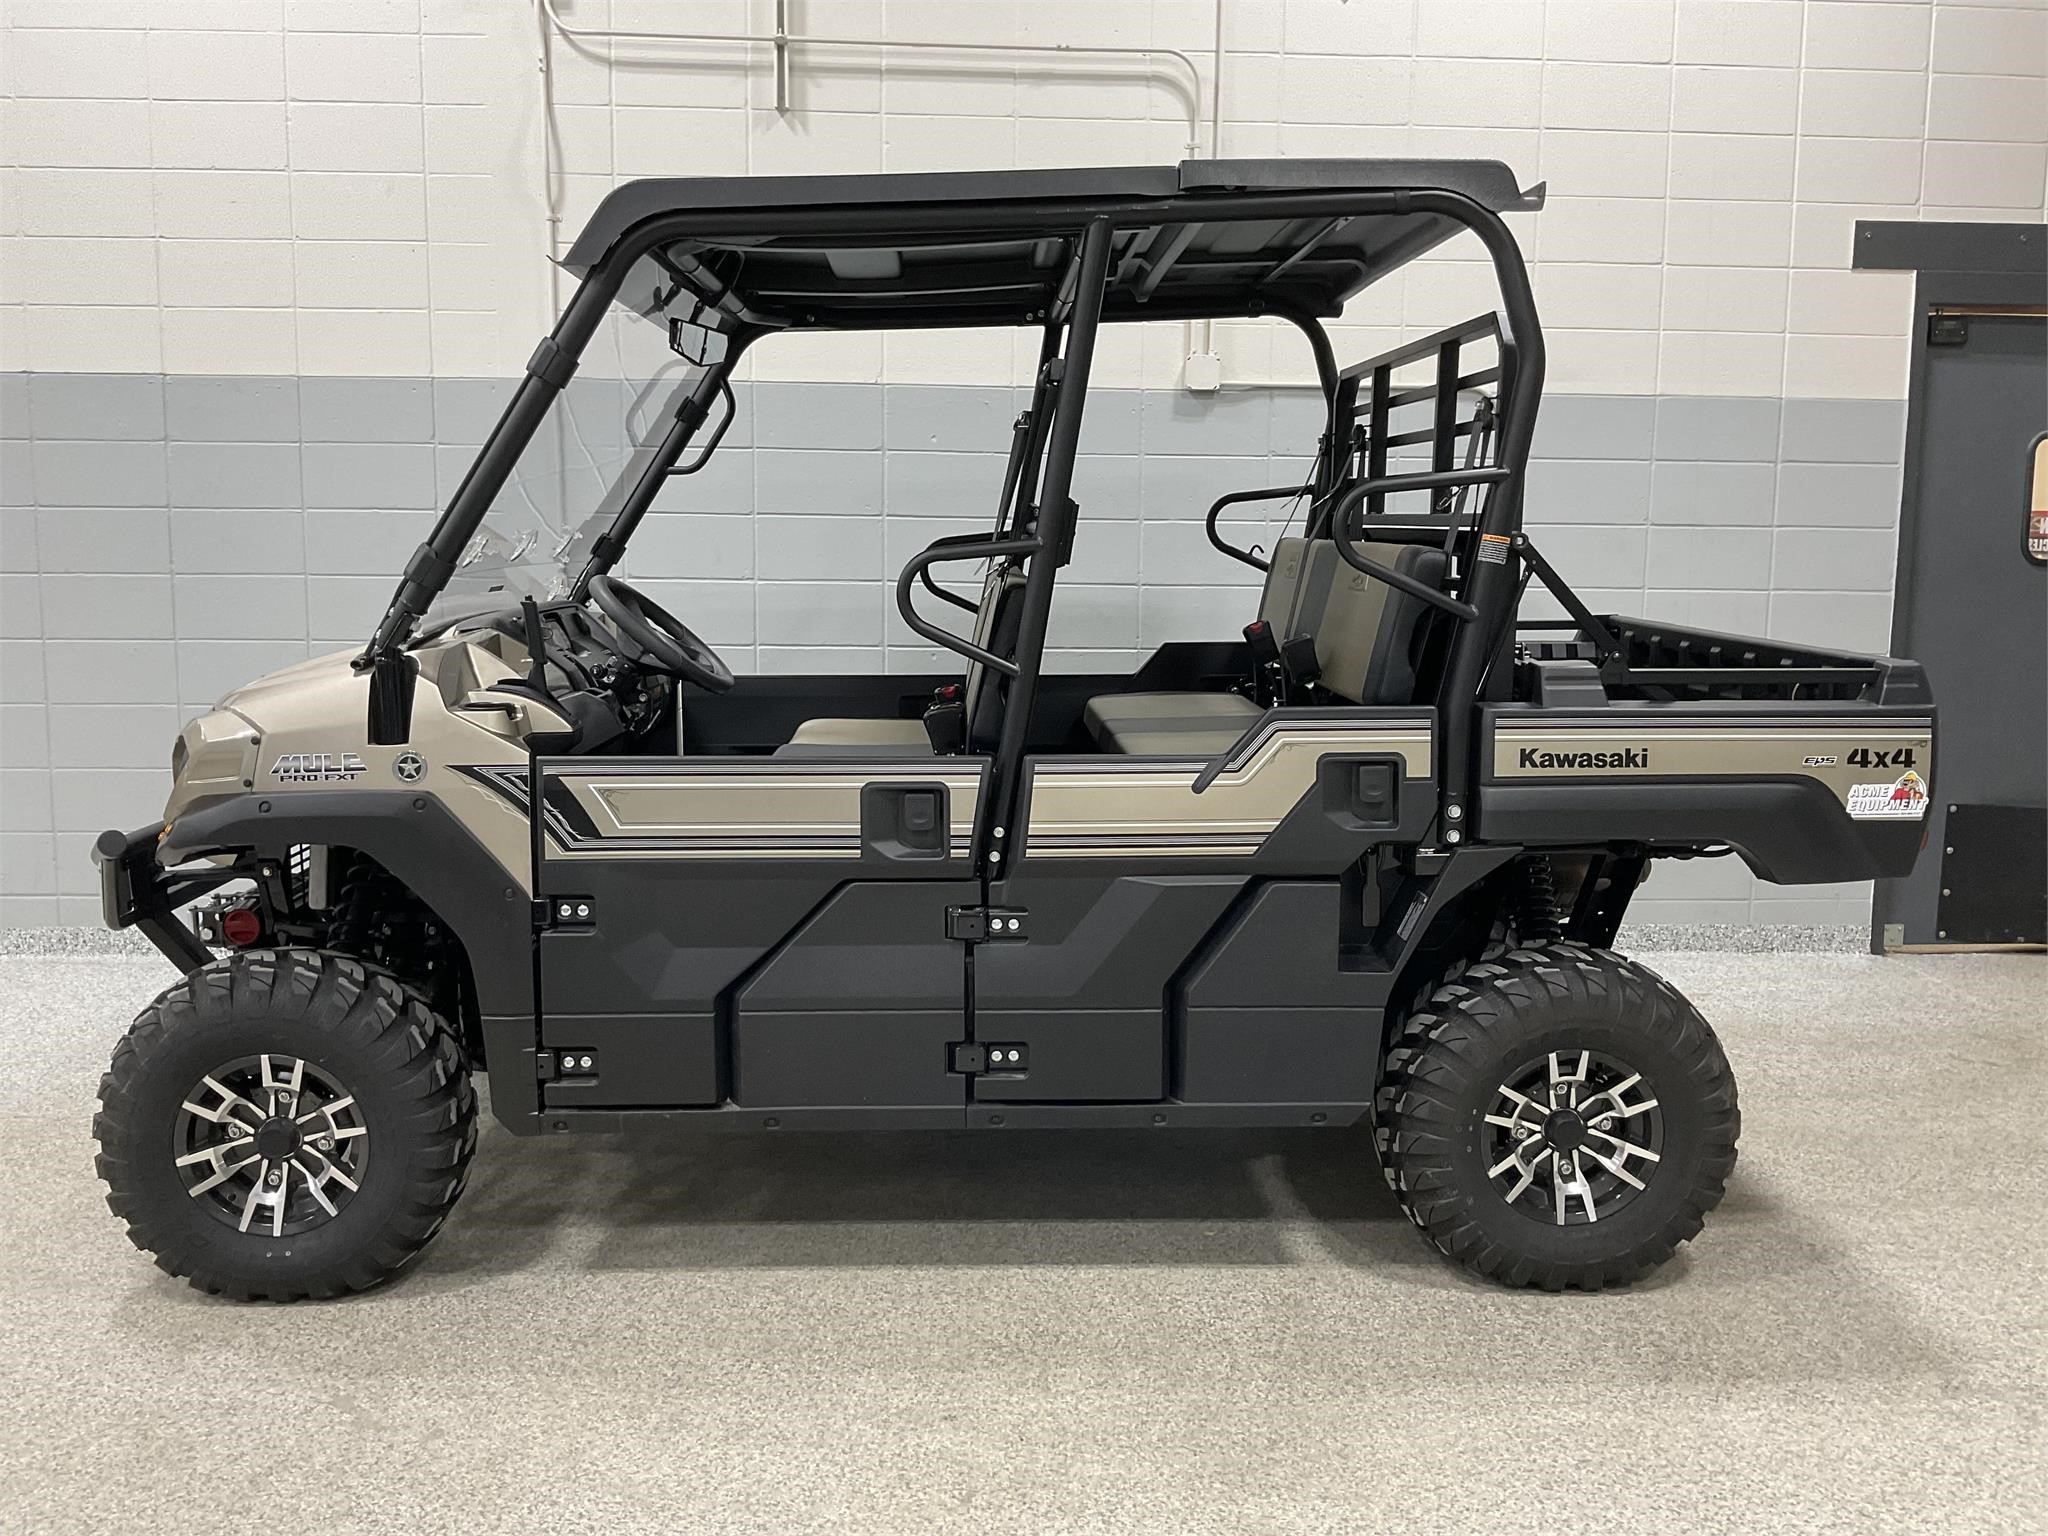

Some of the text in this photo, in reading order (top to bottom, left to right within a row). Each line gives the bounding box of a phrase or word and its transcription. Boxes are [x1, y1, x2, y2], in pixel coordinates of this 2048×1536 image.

[270, 753, 368, 775] MULE
[1519, 747, 1648, 769] Kawasaki
[1847, 748, 1916, 768] 4x4
[1850, 786, 1889, 798] ACME
[1849, 799, 1928, 812] EQUIPMENT
